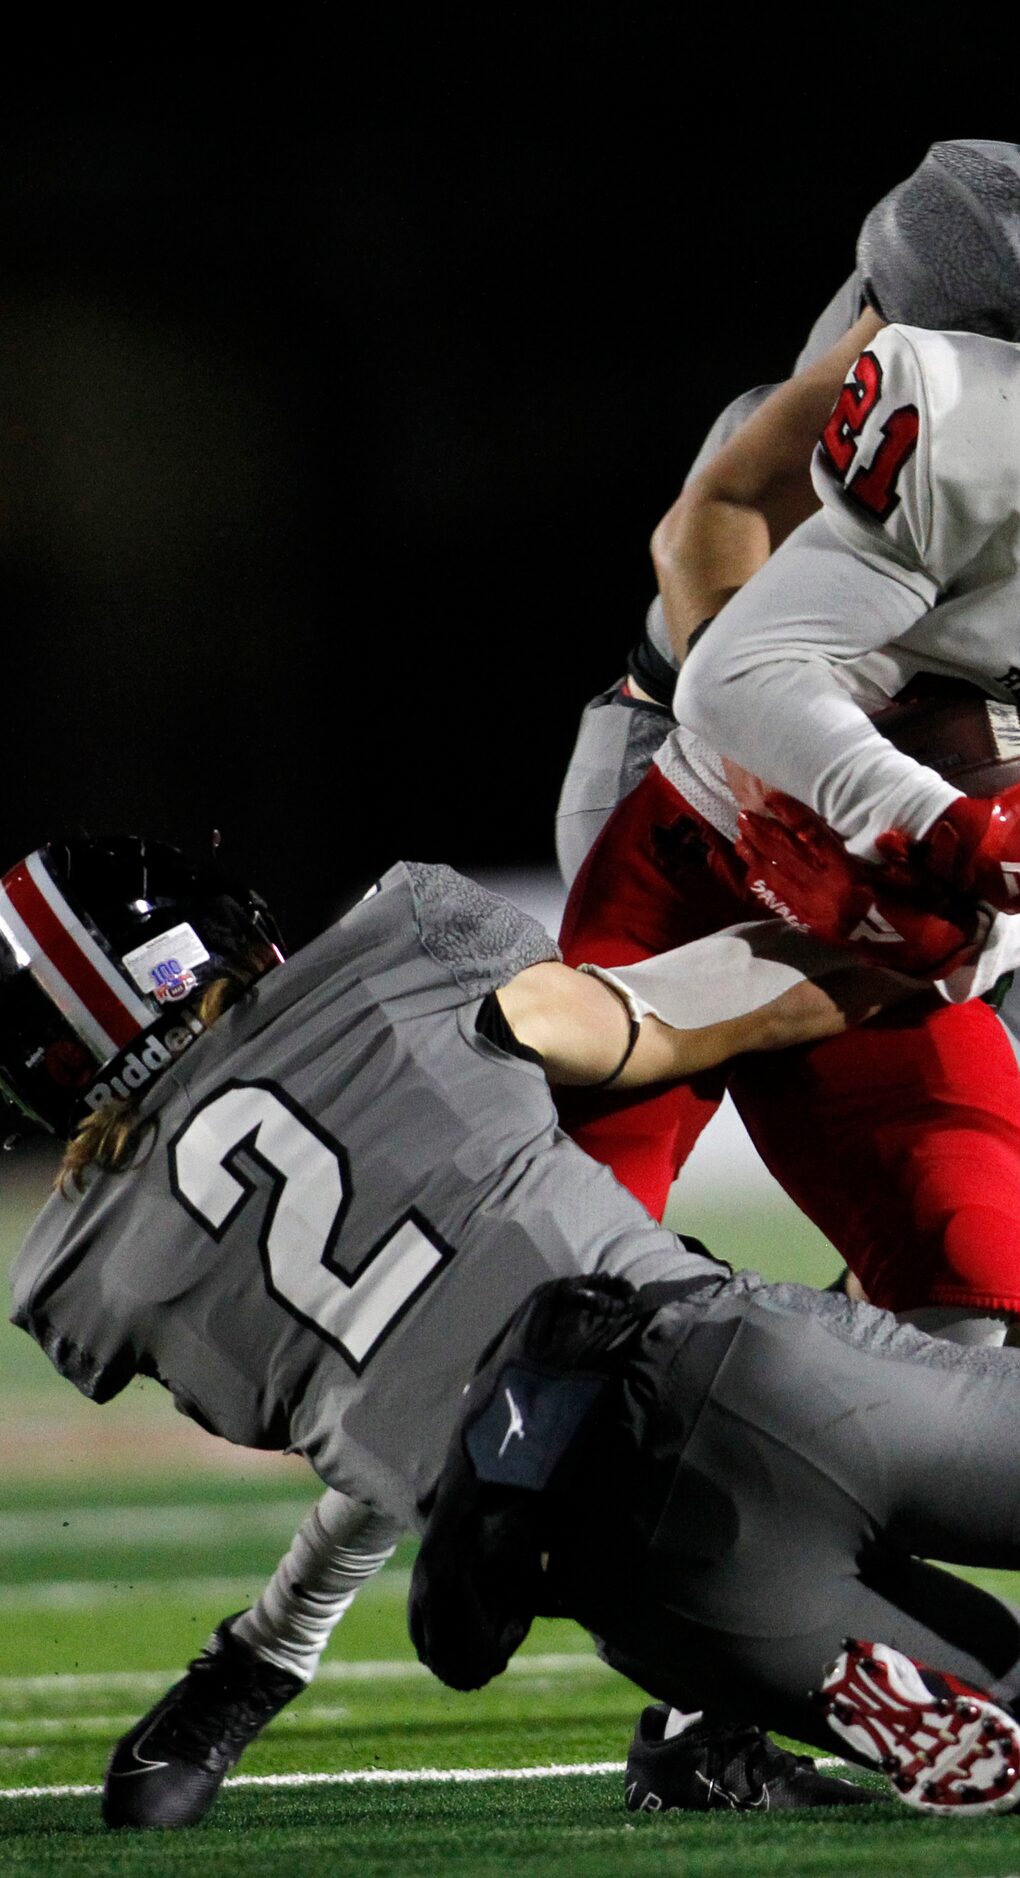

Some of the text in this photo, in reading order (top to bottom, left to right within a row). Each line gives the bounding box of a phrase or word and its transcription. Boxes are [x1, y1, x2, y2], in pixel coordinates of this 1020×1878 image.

[821, 350, 920, 524] 21
[83, 1008, 204, 1112] Riddel
[167, 1076, 457, 1379] 2
